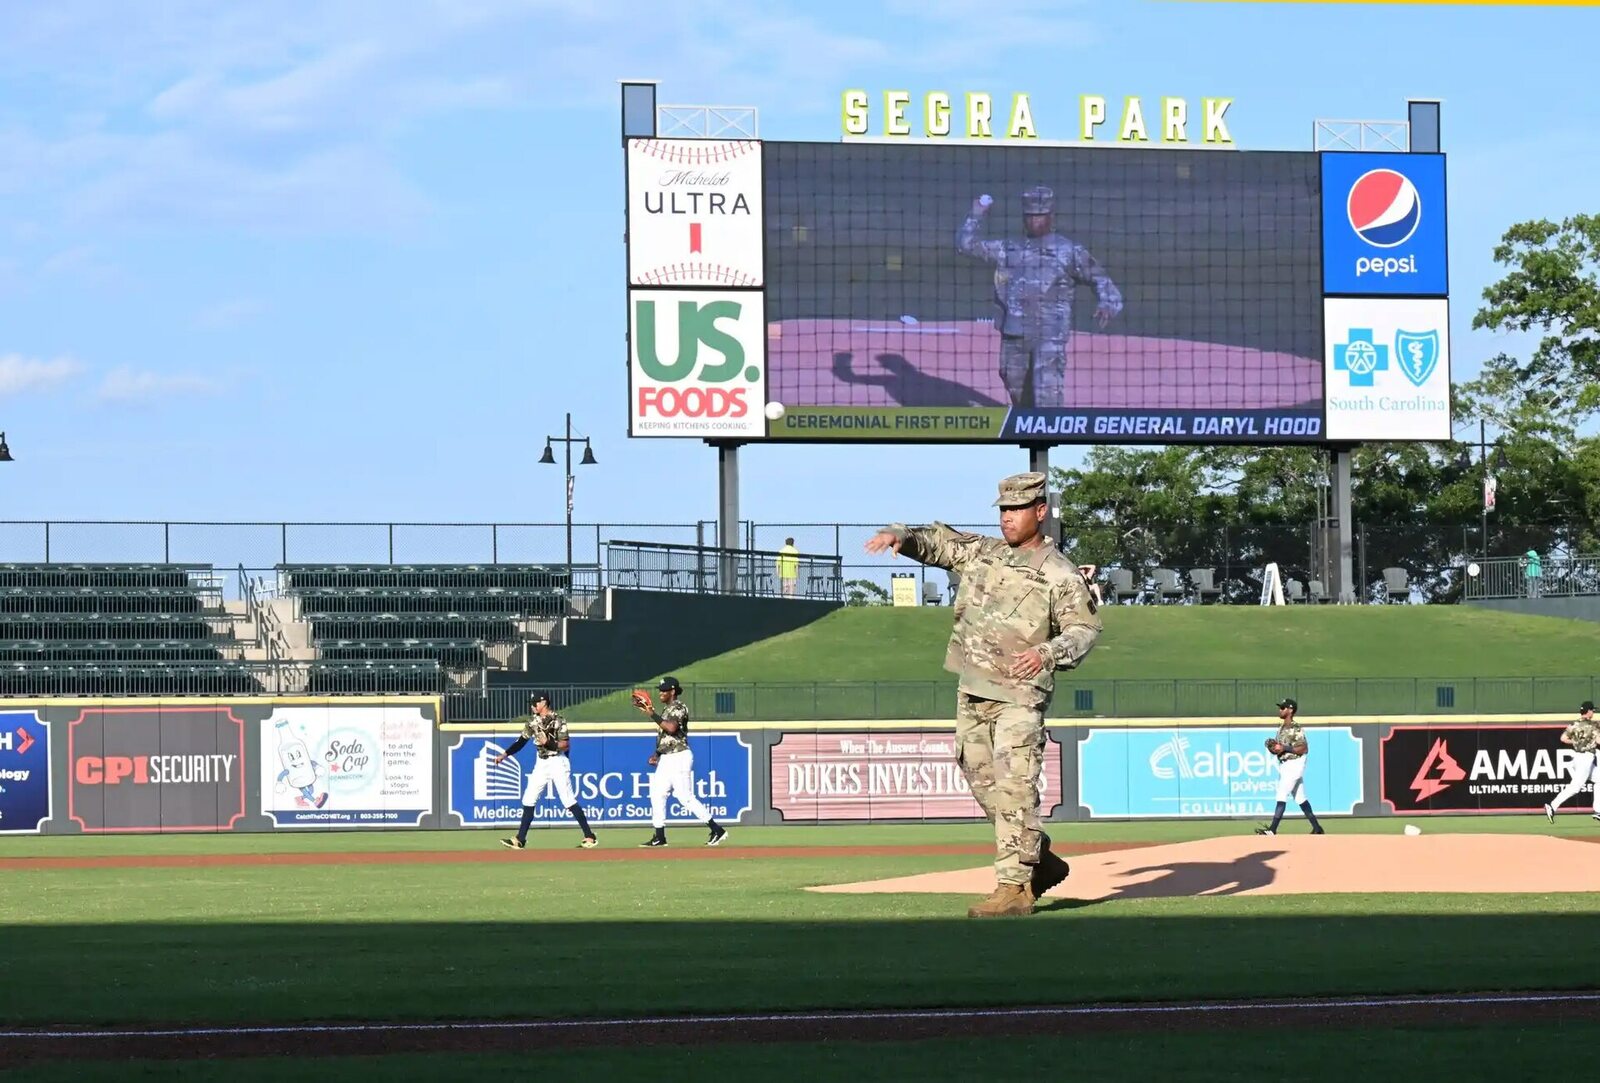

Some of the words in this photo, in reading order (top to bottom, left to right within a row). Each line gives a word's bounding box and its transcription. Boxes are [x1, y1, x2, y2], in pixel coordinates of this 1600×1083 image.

[842, 90, 1037, 138] SEGRA
[1080, 94, 1232, 143] PARK
[659, 169, 730, 187] Michelob
[644, 191, 751, 215] ULTRA
[1356, 254, 1416, 277] pepsi
[638, 387, 748, 418] FOODS
[1329, 395, 1374, 411] South
[1379, 395, 1445, 411] Carolina
[639, 421, 671, 430] KEEPING
[673, 421, 710, 430] KITCHENS
[786, 414, 891, 430] CEREMONIAL
[895, 414, 941, 430] FIRST
[944, 414, 991, 430] PITCH
[1014, 415, 1088, 435] MAJOR
[1094, 415, 1187, 435] GENERAL
[1192, 416, 1258, 436] DARYL
[1264, 417, 1321, 436] HOOD
[325, 738, 364, 762] Soda
[840, 740, 865, 754] When
[866, 740, 884, 754] The
[885, 740, 918, 754] Answer
[75, 756, 148, 785] CPI
[150, 755, 233, 783] SECURITY
[342, 755, 369, 773] Cap
[0, 769, 30, 781] logy
[788, 763, 862, 795] DUKES
[1469, 784, 1519, 794] ULTIMATE
[474, 805, 525, 819] Medica
[607, 804, 623, 817] of
[625, 803, 653, 818] Sou
[670, 803, 727, 817] Carlina
[1182, 802, 1265, 814] COLUMBIA
